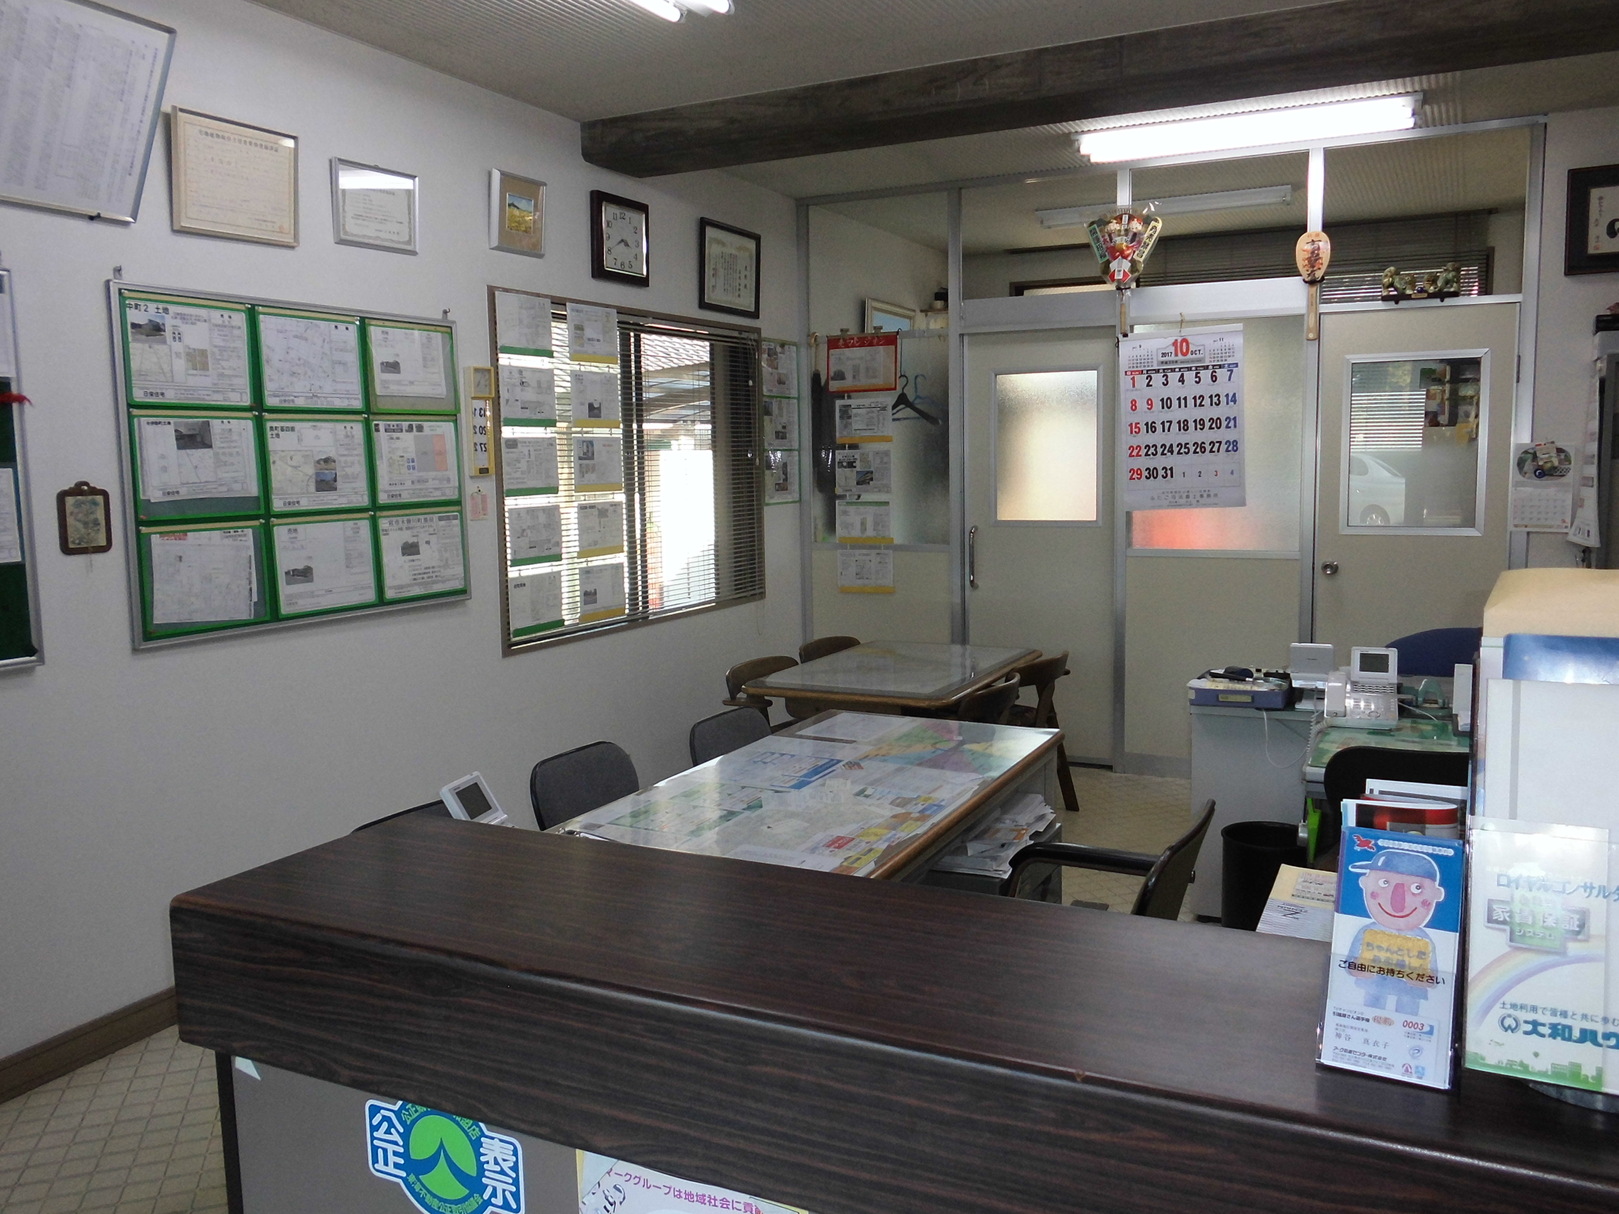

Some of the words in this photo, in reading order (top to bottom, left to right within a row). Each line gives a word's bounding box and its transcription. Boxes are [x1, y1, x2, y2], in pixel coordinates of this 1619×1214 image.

[1172, 338, 1190, 357] 10
[1130, 375, 1136, 388] 1
[1145, 375, 1153, 387] 2
[1162, 374, 1169, 386] 3
[1178, 373, 1185, 385] 4
[1194, 372, 1201, 384] 5
[1210, 370, 1218, 382] 6
[1226, 369, 1233, 381] 7
[1130, 399, 1137, 411] 8
[1146, 398, 1153, 410] 9
[1160, 397, 1172, 410] 10
[1176, 396, 1188, 408] 11
[1192, 395, 1205, 407] 12
[1208, 394, 1221, 406] 13
[1224, 392, 1237, 405] 14
[1128, 422, 1141, 434] 15
[1144, 421, 1157, 434] 16
[1160, 420, 1173, 433] 17
[1176, 419, 1189, 432] 18
[1192, 418, 1205, 430] 19
[1208, 417, 1222, 430] 20
[1224, 416, 1237, 429] 21
[1128, 445, 1142, 457] 22
[1144, 444, 1158, 456] 23
[1160, 443, 1174, 456] 24
[1176, 442, 1190, 455] 25
[1192, 441, 1206, 454] 26
[1209, 441, 1222, 453] 27
[1225, 440, 1238, 452] 28
[1129, 468, 1142, 480] 29
[1145, 467, 1158, 479] 30
[1161, 466, 1174, 479] 31
[1338, 960, 1445, 985] ご自由にお持ちください
[1402, 1020, 1425, 1031] 0003
[372, 1109, 406, 1177] 公正
[480, 1137, 517, 1209] 表示
